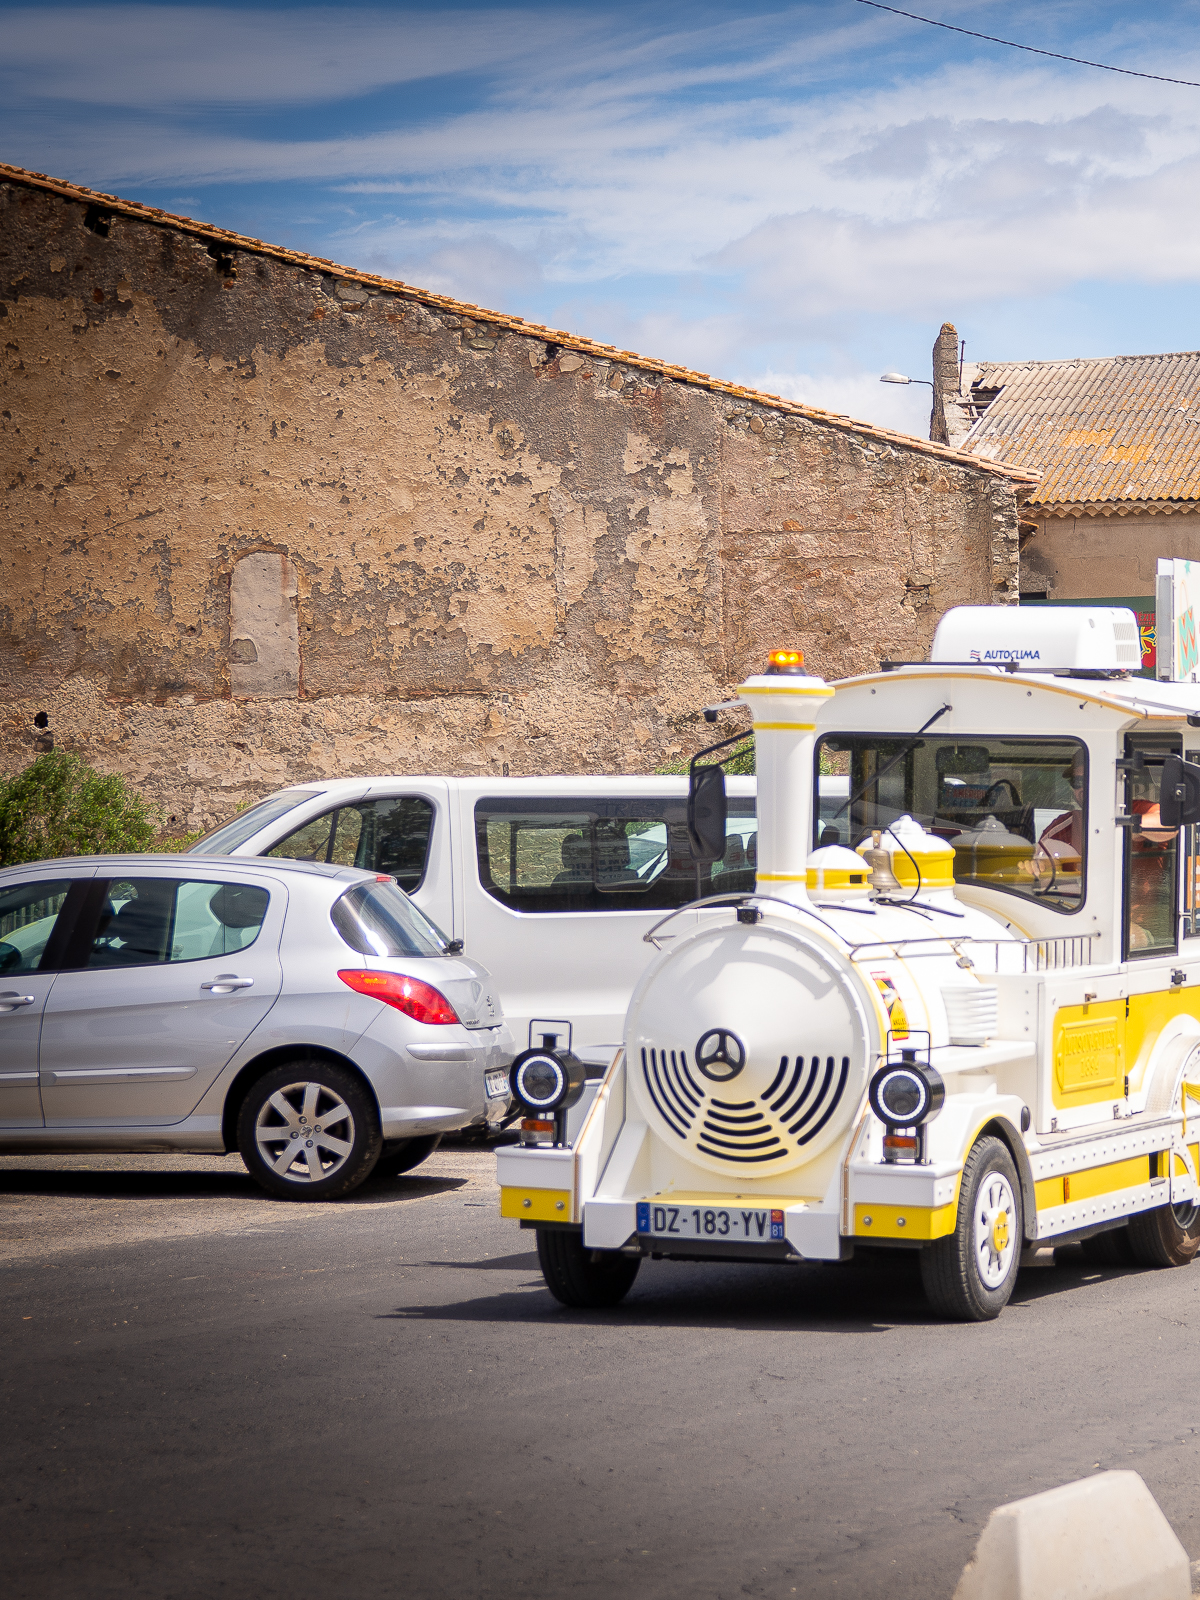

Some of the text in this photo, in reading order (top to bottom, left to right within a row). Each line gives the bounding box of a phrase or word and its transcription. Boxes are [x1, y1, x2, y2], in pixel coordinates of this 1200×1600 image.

[984, 650, 1040, 660] AUTOCLIMA
[654, 1207, 767, 1237] DZ-183-YV
[772, 1224, 783, 1236] 81
